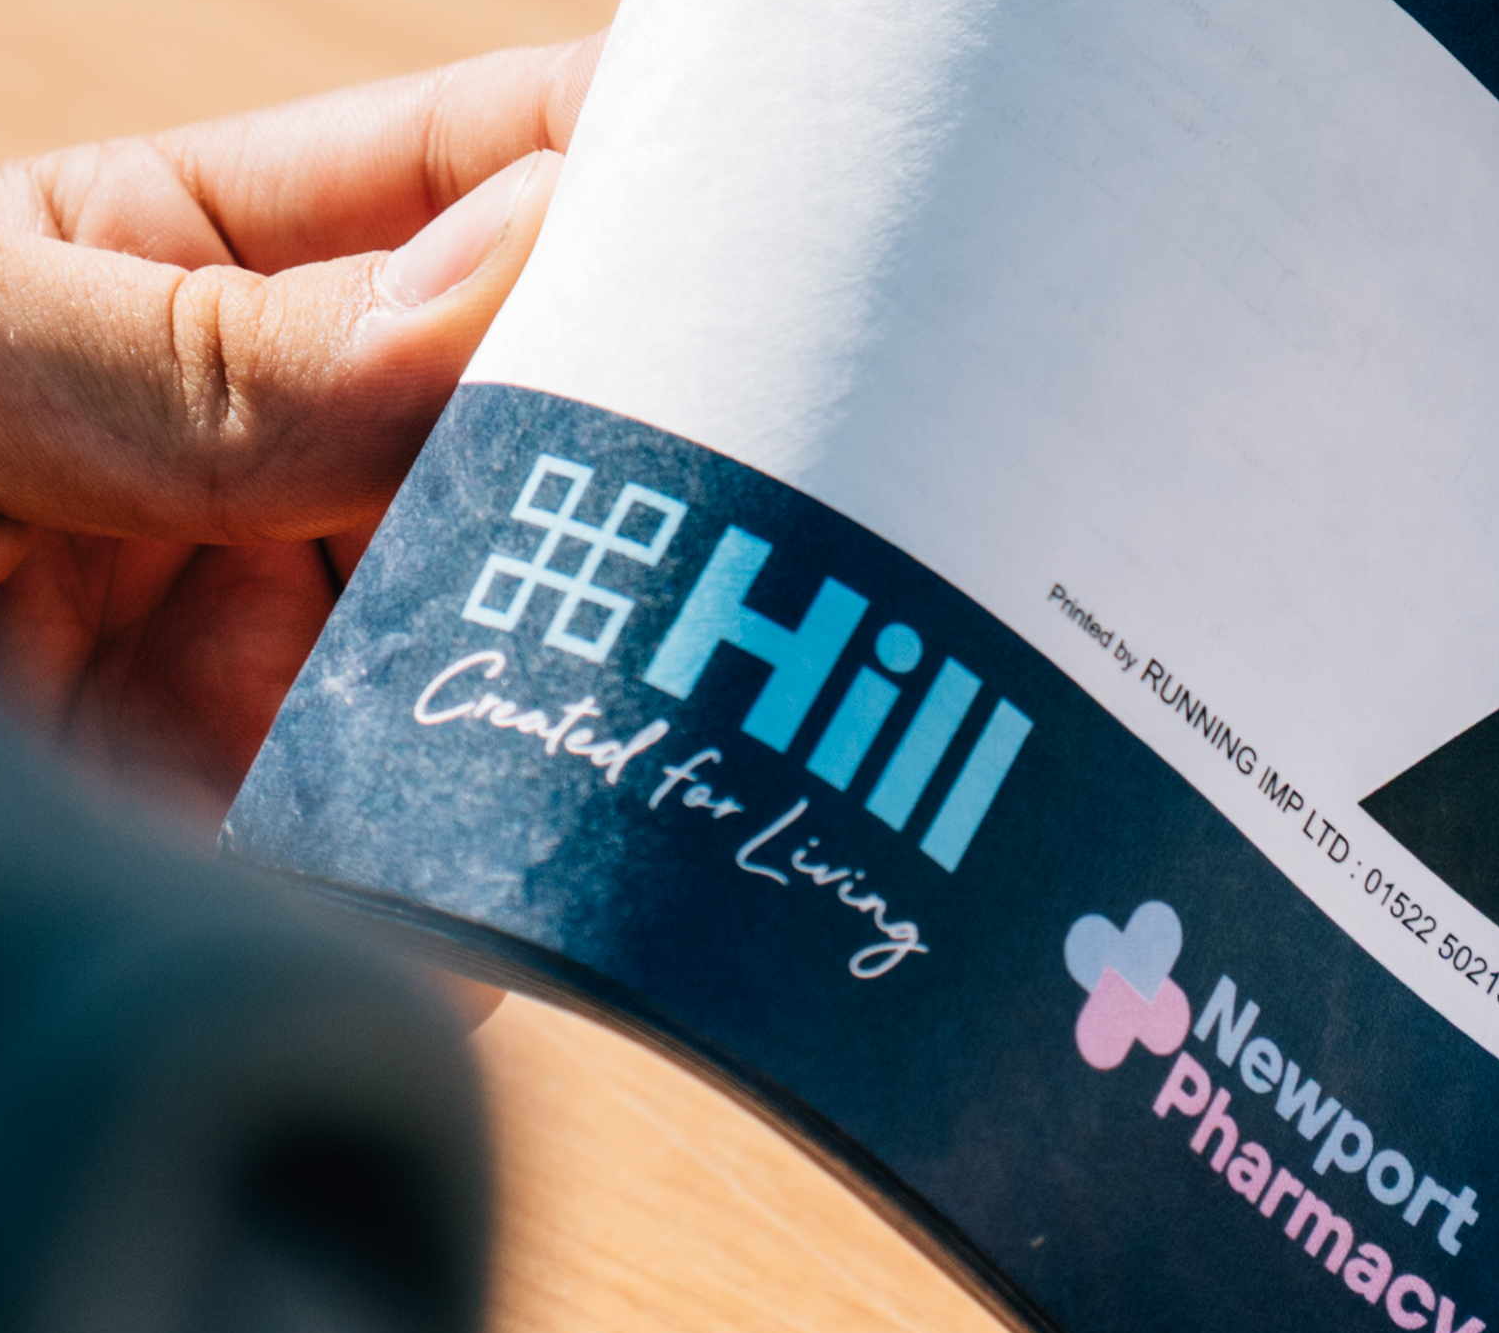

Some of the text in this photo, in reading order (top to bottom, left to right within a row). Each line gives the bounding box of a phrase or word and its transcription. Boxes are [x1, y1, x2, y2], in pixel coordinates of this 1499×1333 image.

[413, 649, 929, 980] Created for Living
[643, 523, 1034, 874] Hill
[1047, 582, 1115, 650] Printed
[1114, 638, 1139, 673] by
[1140, 657, 1258, 777] RUNNING
[1257, 765, 1305, 814] IMP
[1301, 807, 1350, 864] LTD
[1363, 867, 1438, 945] 01522
[1192, 973, 1480, 1257] Newport
